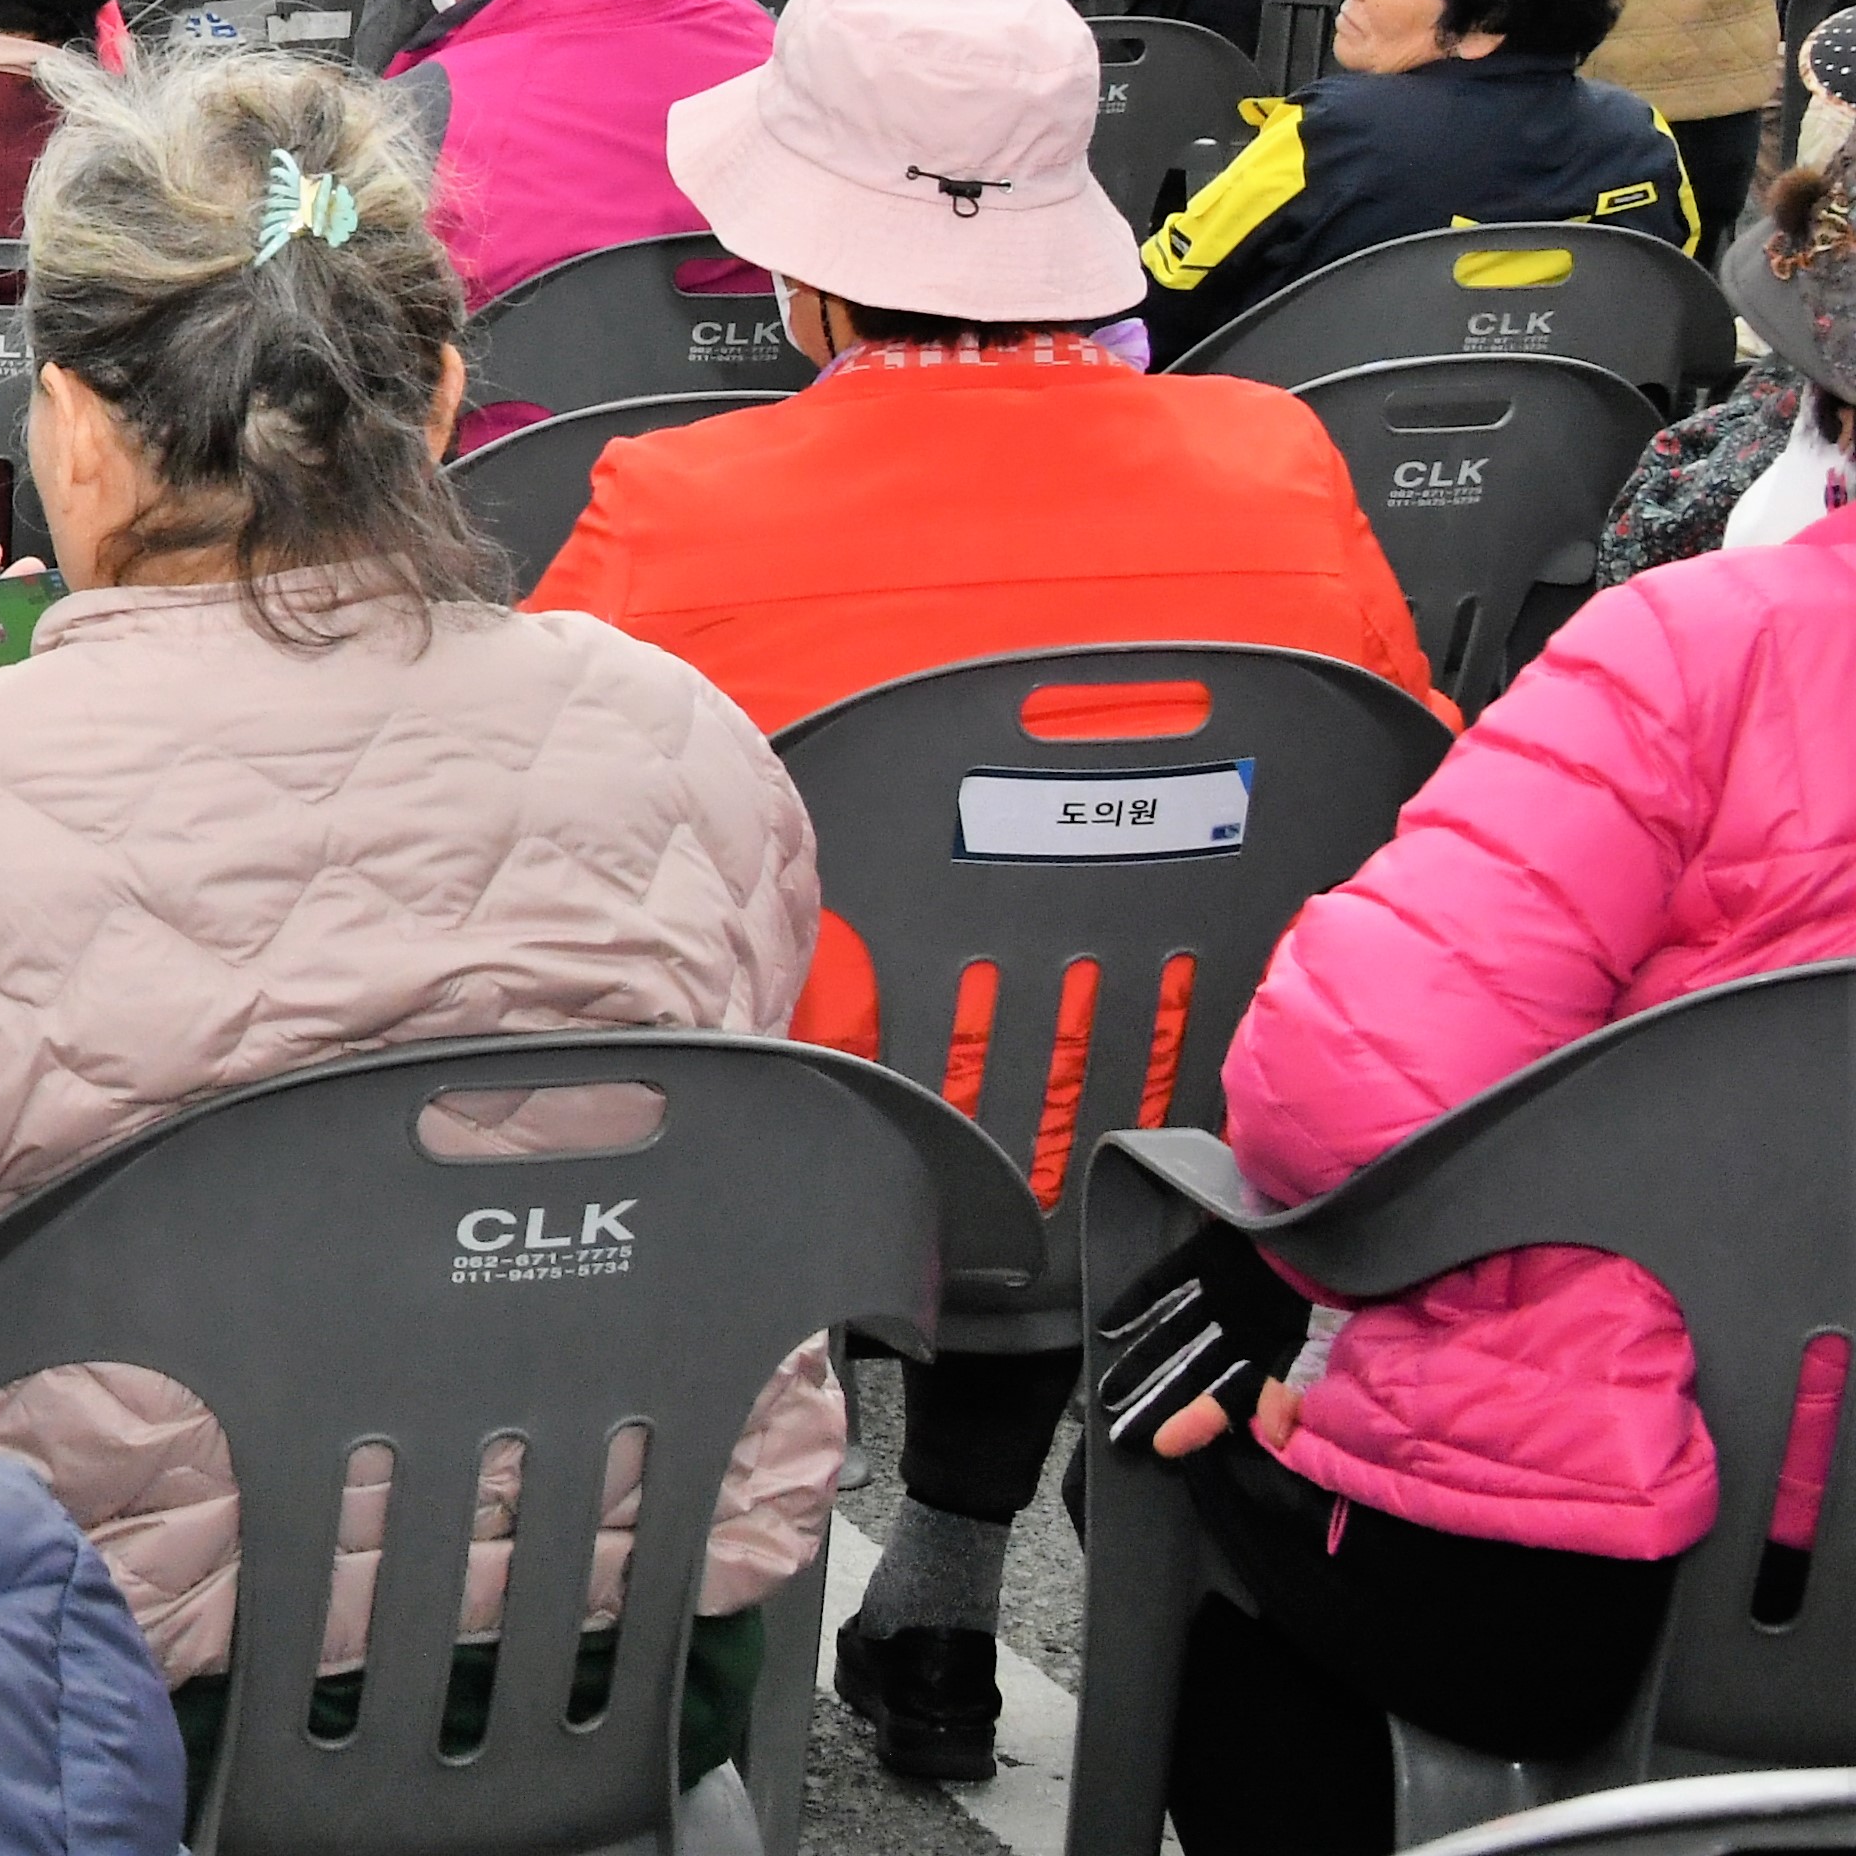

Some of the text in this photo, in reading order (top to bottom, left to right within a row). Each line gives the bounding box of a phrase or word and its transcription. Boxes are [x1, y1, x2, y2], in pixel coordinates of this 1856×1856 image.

[691, 321, 783, 346] CLK
[1468, 310, 1555, 336] CLK
[1393, 458, 1490, 489] CLK
[1057, 798, 1158, 828] 도의원
[456, 1199, 639, 1252] CLK
[453, 1245, 633, 1270] 062-671-7775
[452, 1261, 630, 1284] 011-9475-5734
